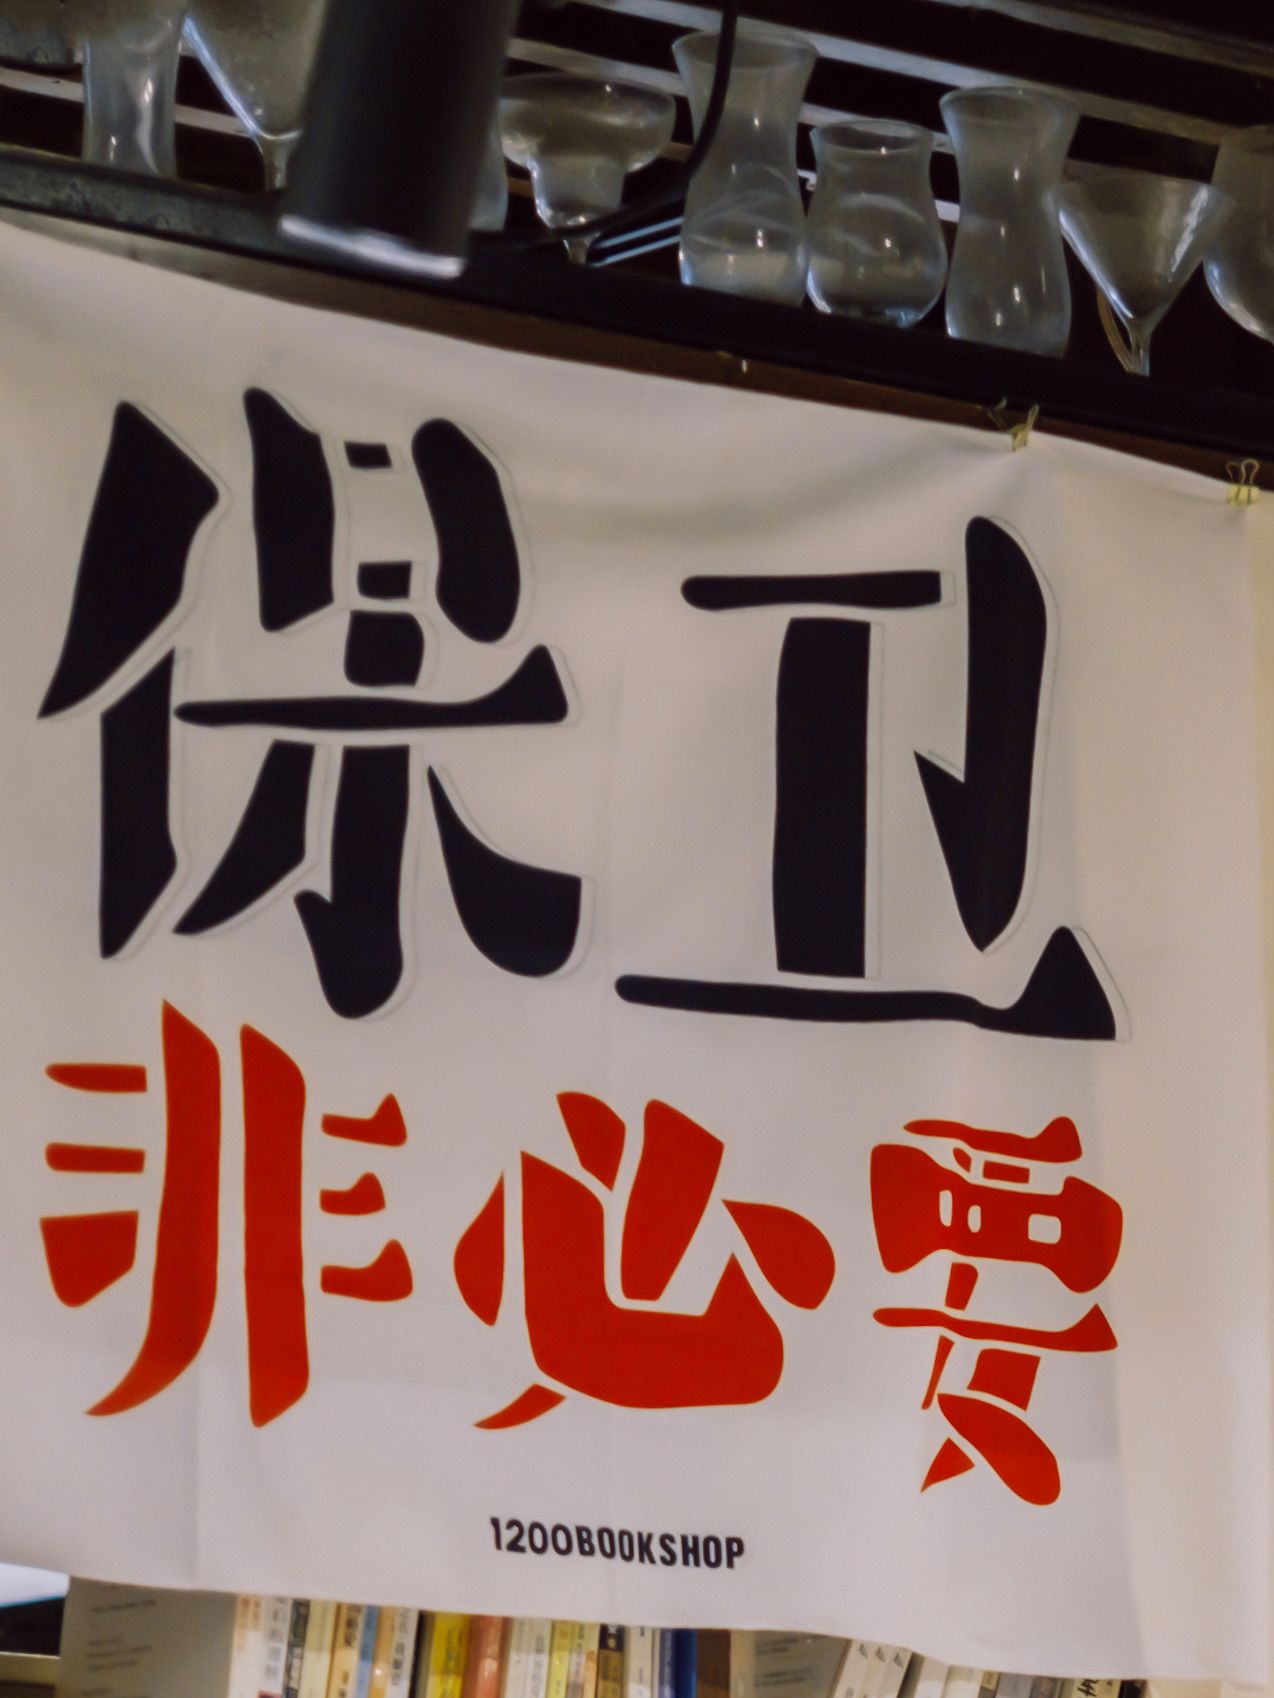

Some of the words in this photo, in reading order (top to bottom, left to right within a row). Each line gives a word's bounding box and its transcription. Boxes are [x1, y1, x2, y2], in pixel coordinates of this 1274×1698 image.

[38, 386, 1120, 1042] 保卫
[38, 999, 1125, 1506] 非必要
[489, 1516, 746, 1570] 1200BOOKSHOP
